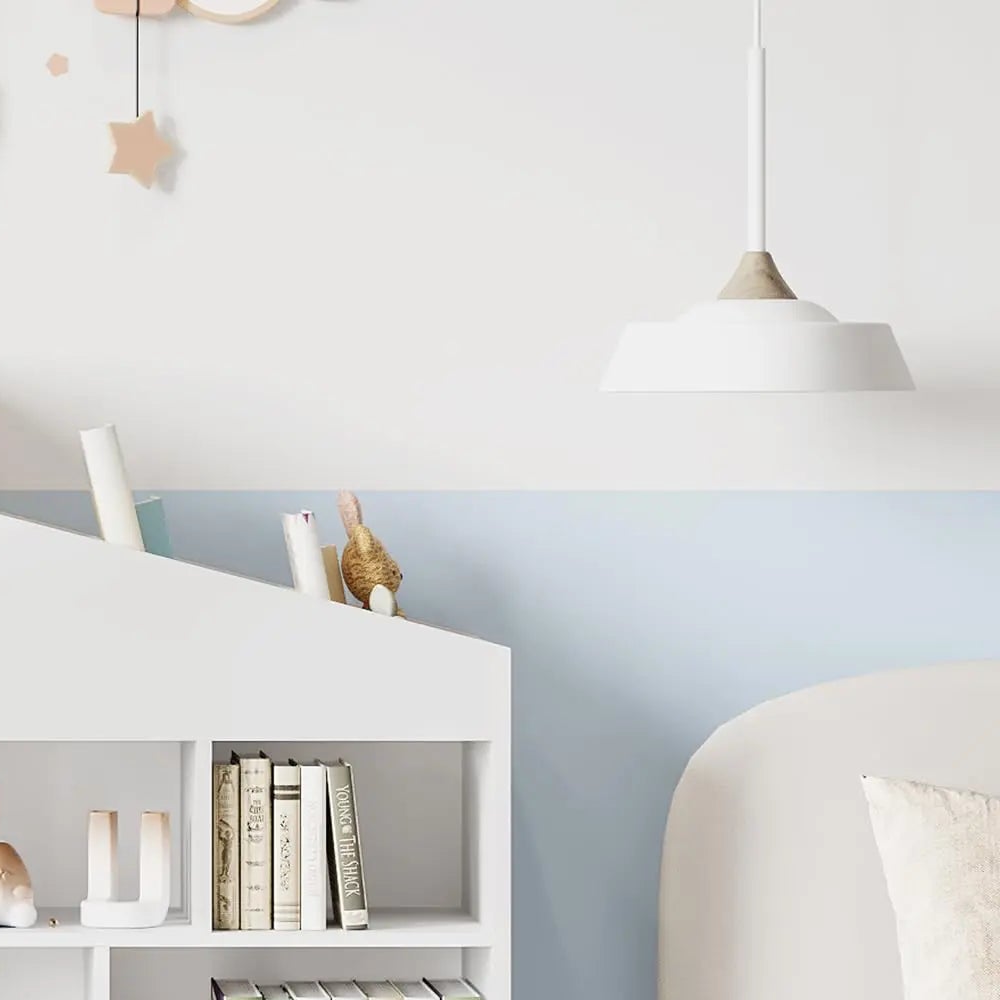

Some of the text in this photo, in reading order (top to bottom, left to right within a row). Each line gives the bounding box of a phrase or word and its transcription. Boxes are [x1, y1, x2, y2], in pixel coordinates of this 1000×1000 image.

[335, 784, 361, 897] YOUNG THE SHACK
